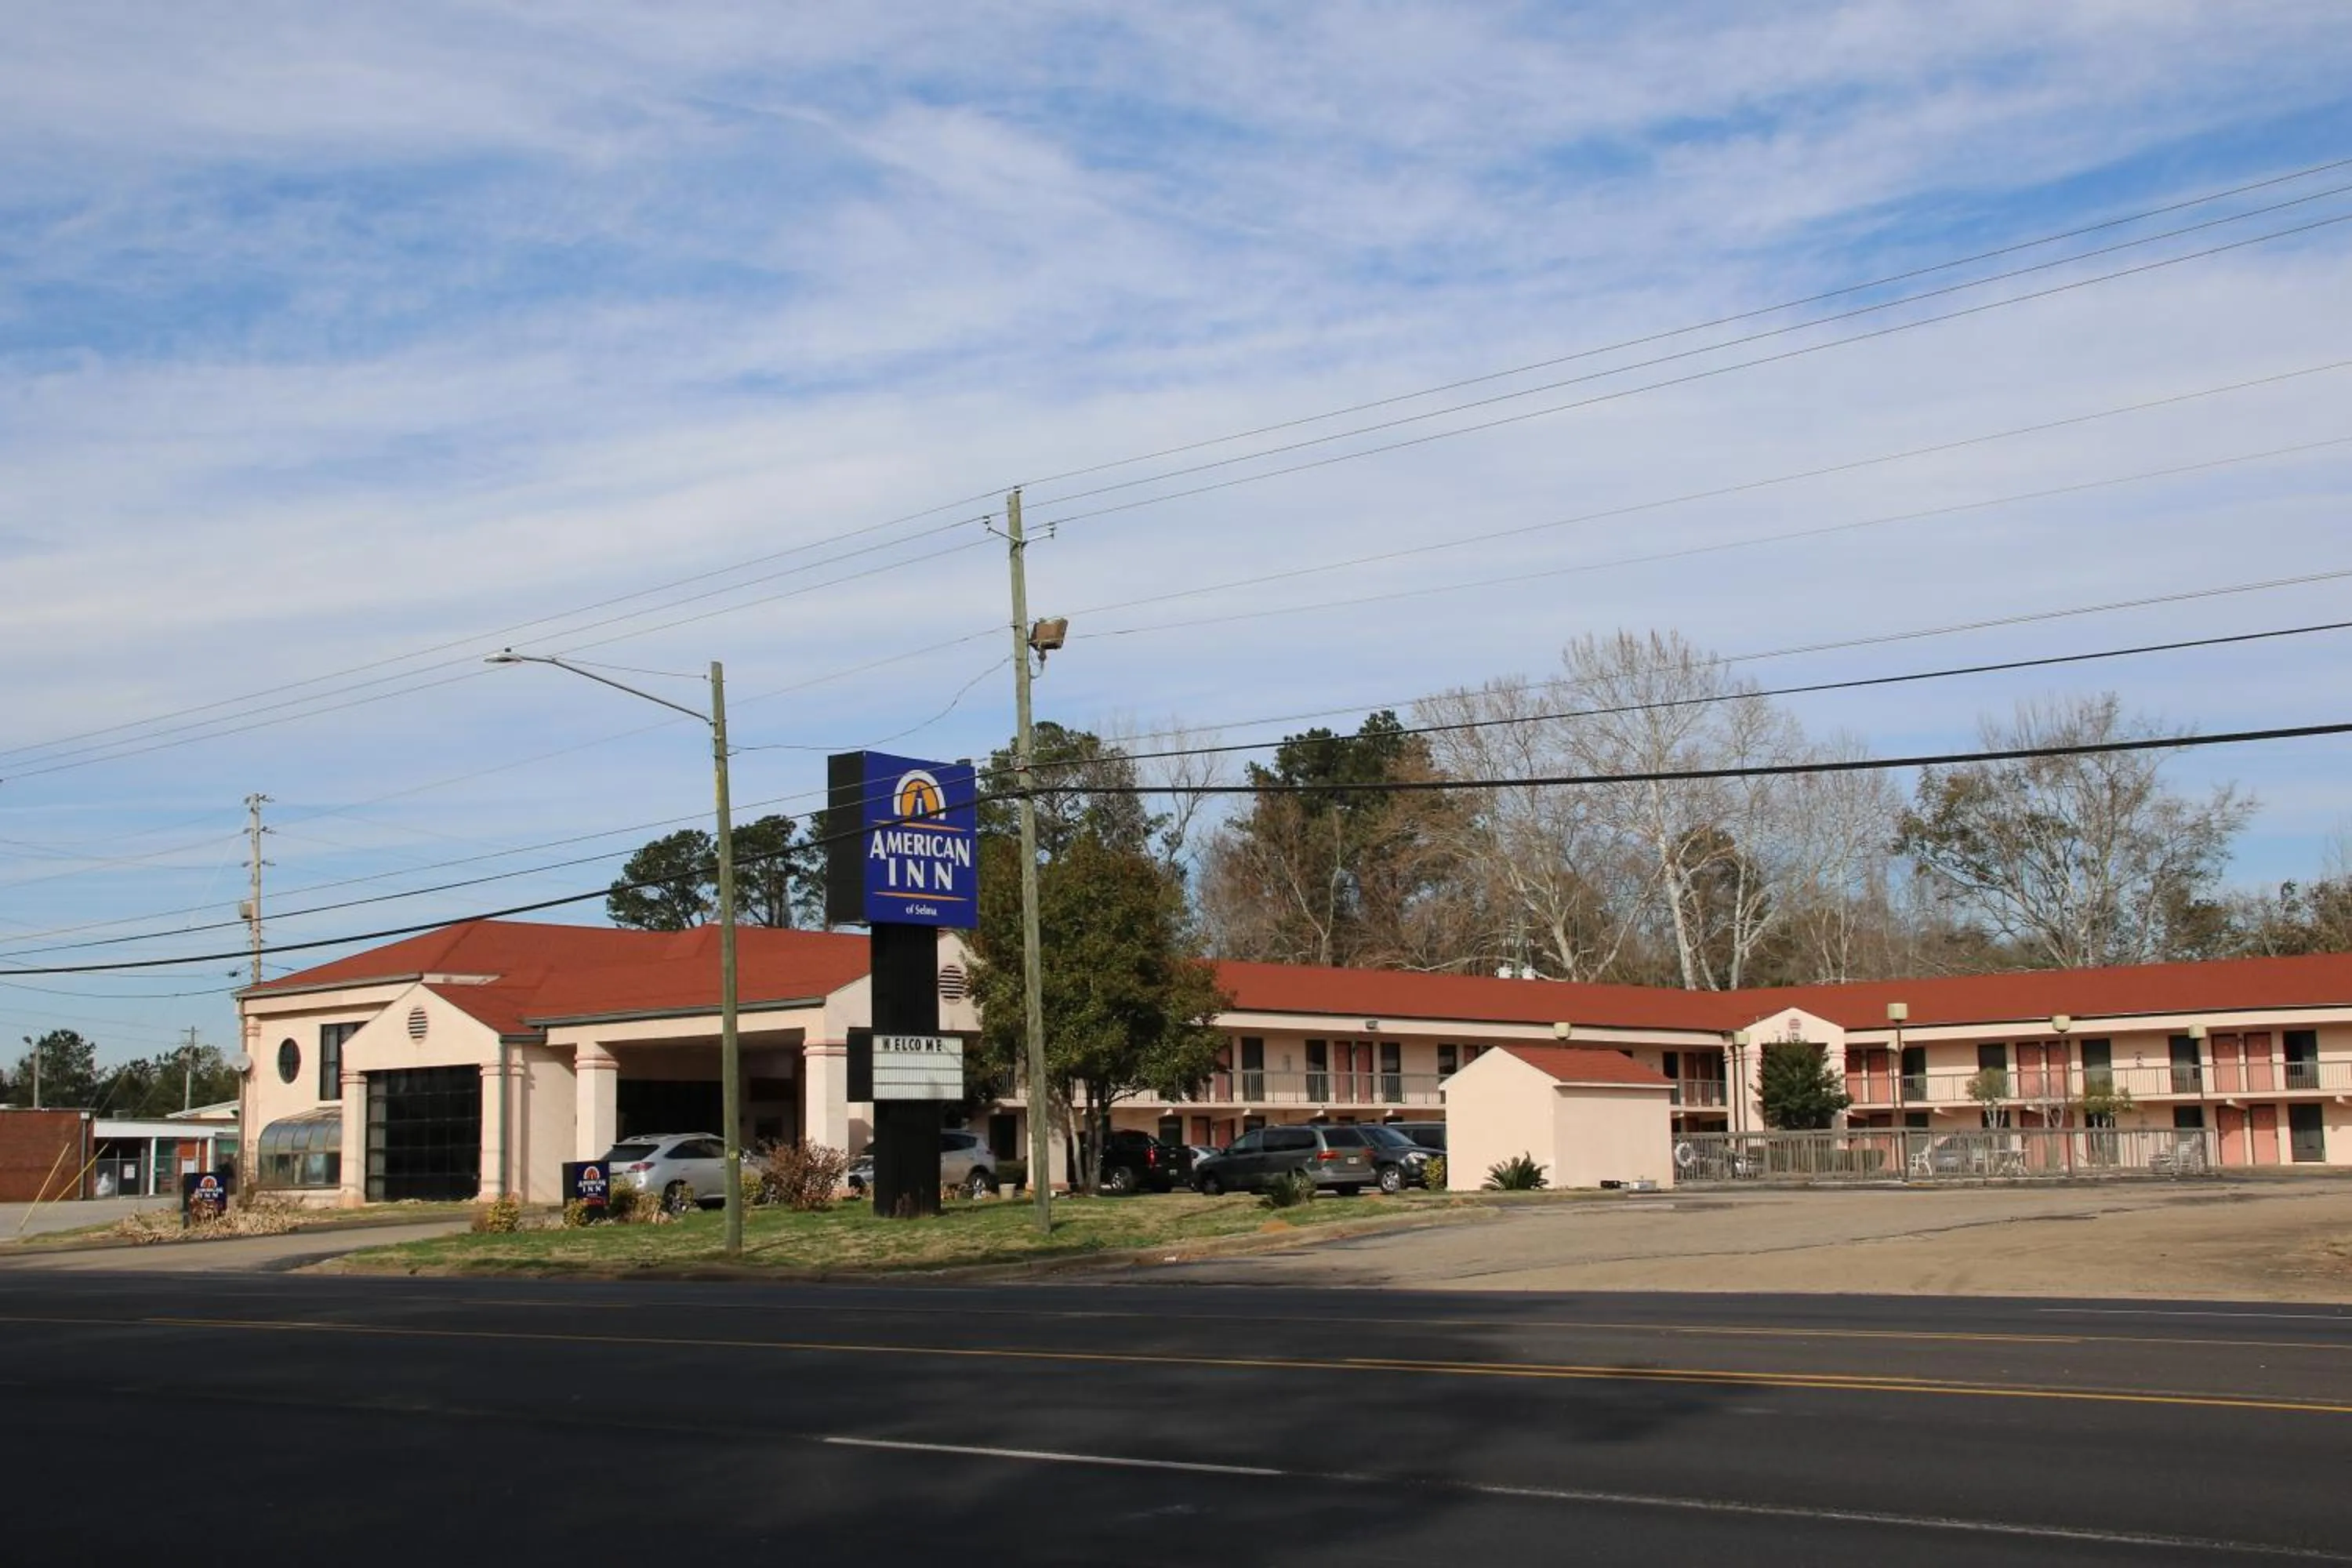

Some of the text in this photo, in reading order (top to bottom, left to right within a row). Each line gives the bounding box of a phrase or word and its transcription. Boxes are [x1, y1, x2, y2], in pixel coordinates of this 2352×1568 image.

[869, 829, 971, 867] AMERICAN
[889, 858, 953, 891] INN
[906, 904, 914, 915] of
[883, 1038, 942, 1051] WELCOME
